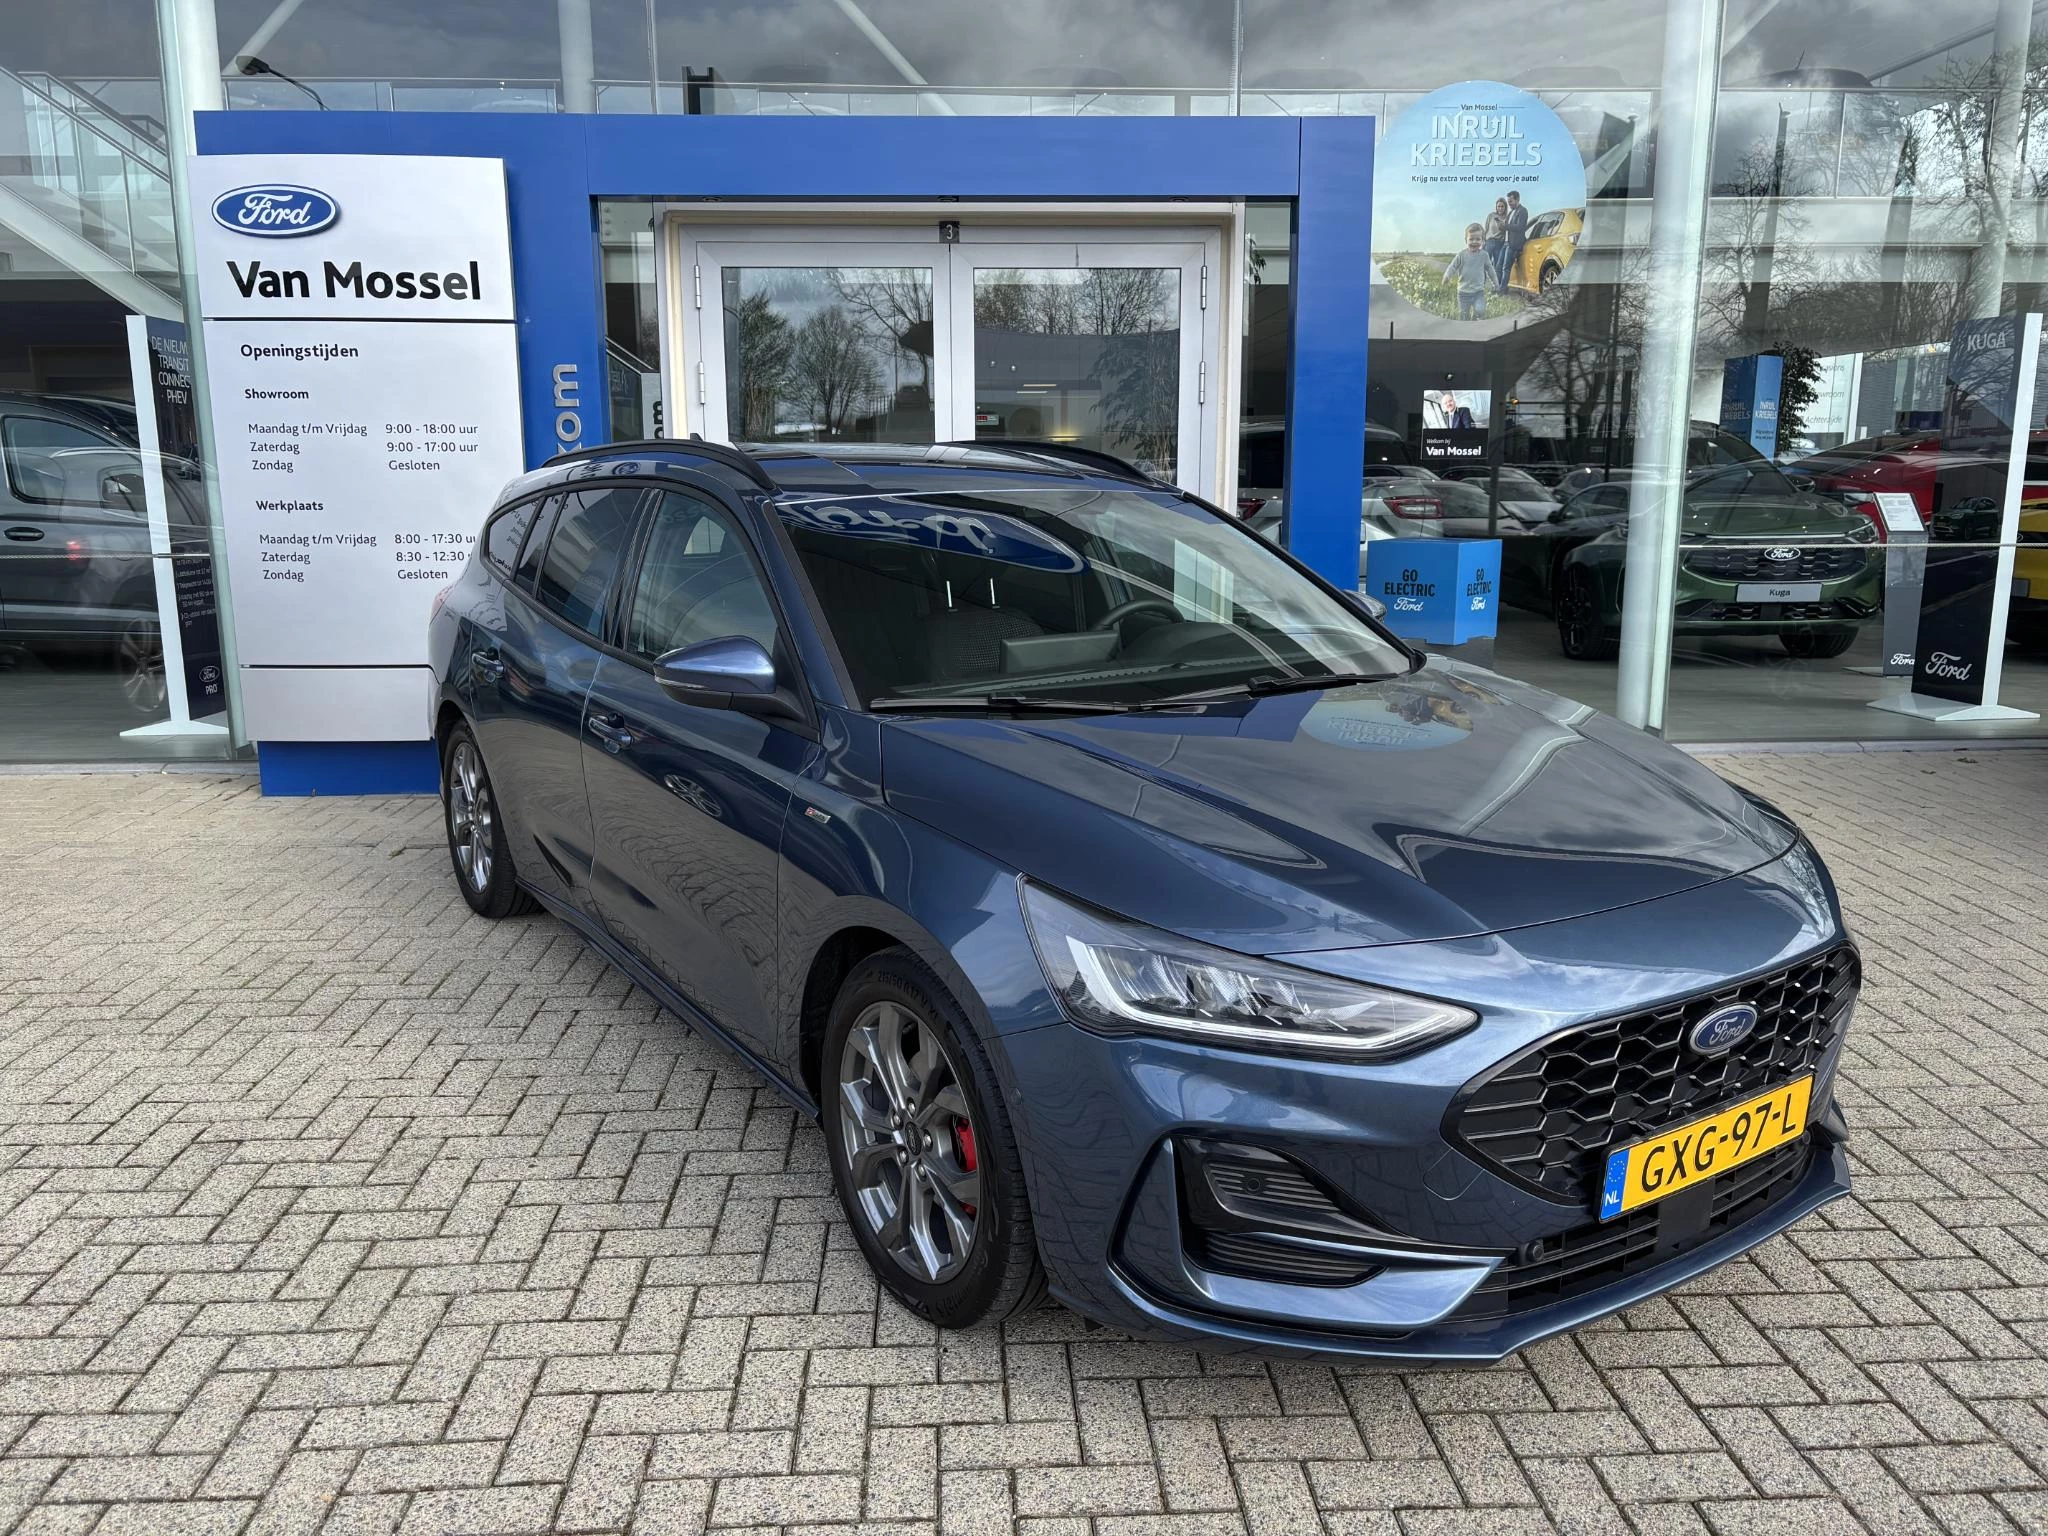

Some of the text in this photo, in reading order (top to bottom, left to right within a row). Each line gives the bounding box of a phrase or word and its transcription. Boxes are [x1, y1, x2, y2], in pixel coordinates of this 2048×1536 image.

[1475, 103, 1498, 111] Mossel
[1431, 113, 1525, 140] INRUIL
[1410, 142, 1543, 167] KRIEBELS
[1411, 175, 1428, 183] Krijg
[1459, 174, 1474, 182] veel
[1475, 175, 1494, 183] terug
[1512, 175, 1520, 183] je
[237, 193, 311, 225] Ford
[946, 224, 953, 240] 3
[226, 260, 481, 300] Van Mossel
[151, 336, 189, 355] DE NIEUW
[1966, 331, 2007, 351] KUGA
[240, 344, 359, 361] Openingstijden
[157, 354, 189, 372] TRANSIT
[158, 371, 191, 388] CONNEC
[166, 389, 188, 404] PHEV
[244, 388, 309, 400] Showroom
[248, 423, 300, 436] Maandag
[302, 423, 323, 434] t/m
[325, 423, 368, 436] Vrijdag
[385, 423, 412, 434] 9:00
[423, 423, 456, 434] 18:00
[459, 425, 479, 434] uur
[250, 441, 300, 454] Zaterdag
[386, 442, 413, 452] 9:00
[424, 442, 456, 452] 17:00
[459, 444, 479, 452] uur
[1426, 445, 1482, 456] Van Mossel
[252, 459, 440, 473] Zondag Gesloten
[255, 500, 324, 513] Werkplaats
[259, 534, 310, 547] Maandag
[312, 534, 333, 545] t/m
[336, 534, 377, 547] Vrijdag
[394, 534, 421, 544] 8:00
[433, 533, 463, 544] 17:30
[261, 552, 311, 564] Zaterdag
[396, 552, 422, 562] 8:30
[433, 552, 465, 562] 12:30
[1770, 547, 1794, 558] Ford
[263, 569, 448, 582] Zondag Gesloten
[1402, 569, 1418, 582] GO
[1475, 568, 1485, 581] GO
[1384, 582, 1436, 597] ELECTRIC
[1466, 581, 1492, 597] ELECTRIC
[1769, 589, 1791, 597] Kuga
[1393, 597, 1424, 611] Ford
[1470, 596, 1487, 611] Ford
[1925, 651, 1972, 680] Ford
[205, 684, 218, 695] PRO
[1710, 1016, 1745, 1043] Ford
[1640, 1093, 1797, 1193] GXG-97-L
[1604, 1190, 1620, 1207] NL
